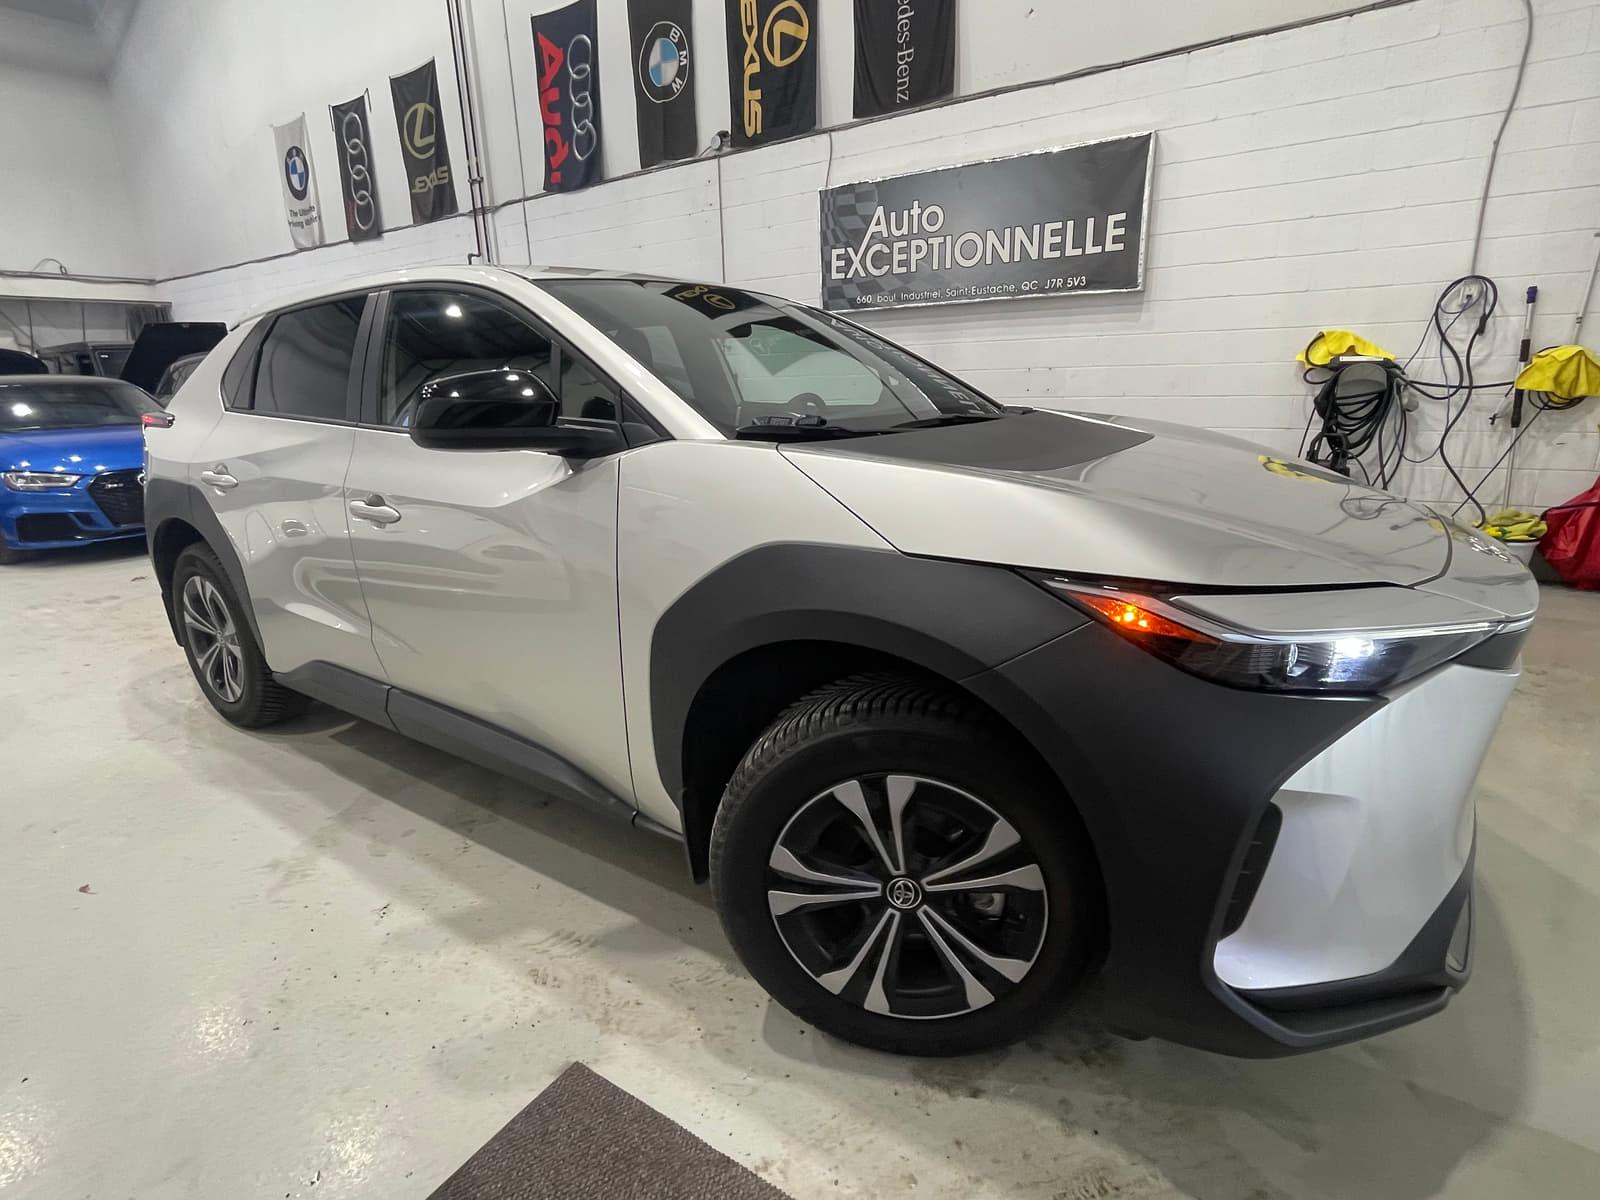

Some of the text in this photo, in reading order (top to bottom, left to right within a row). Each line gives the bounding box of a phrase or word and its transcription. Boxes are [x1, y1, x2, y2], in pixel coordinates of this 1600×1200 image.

[669, 27, 687, 93] BMW
[868, 200, 945, 239] Auto
[831, 212, 1127, 280] EXCEPTIONNELLE
[945, 283, 1018, 298] Saint-Eustache,
[1021, 280, 1039, 291] QC
[1044, 278, 1064, 289] J7R
[1066, 276, 1087, 287] 5V3
